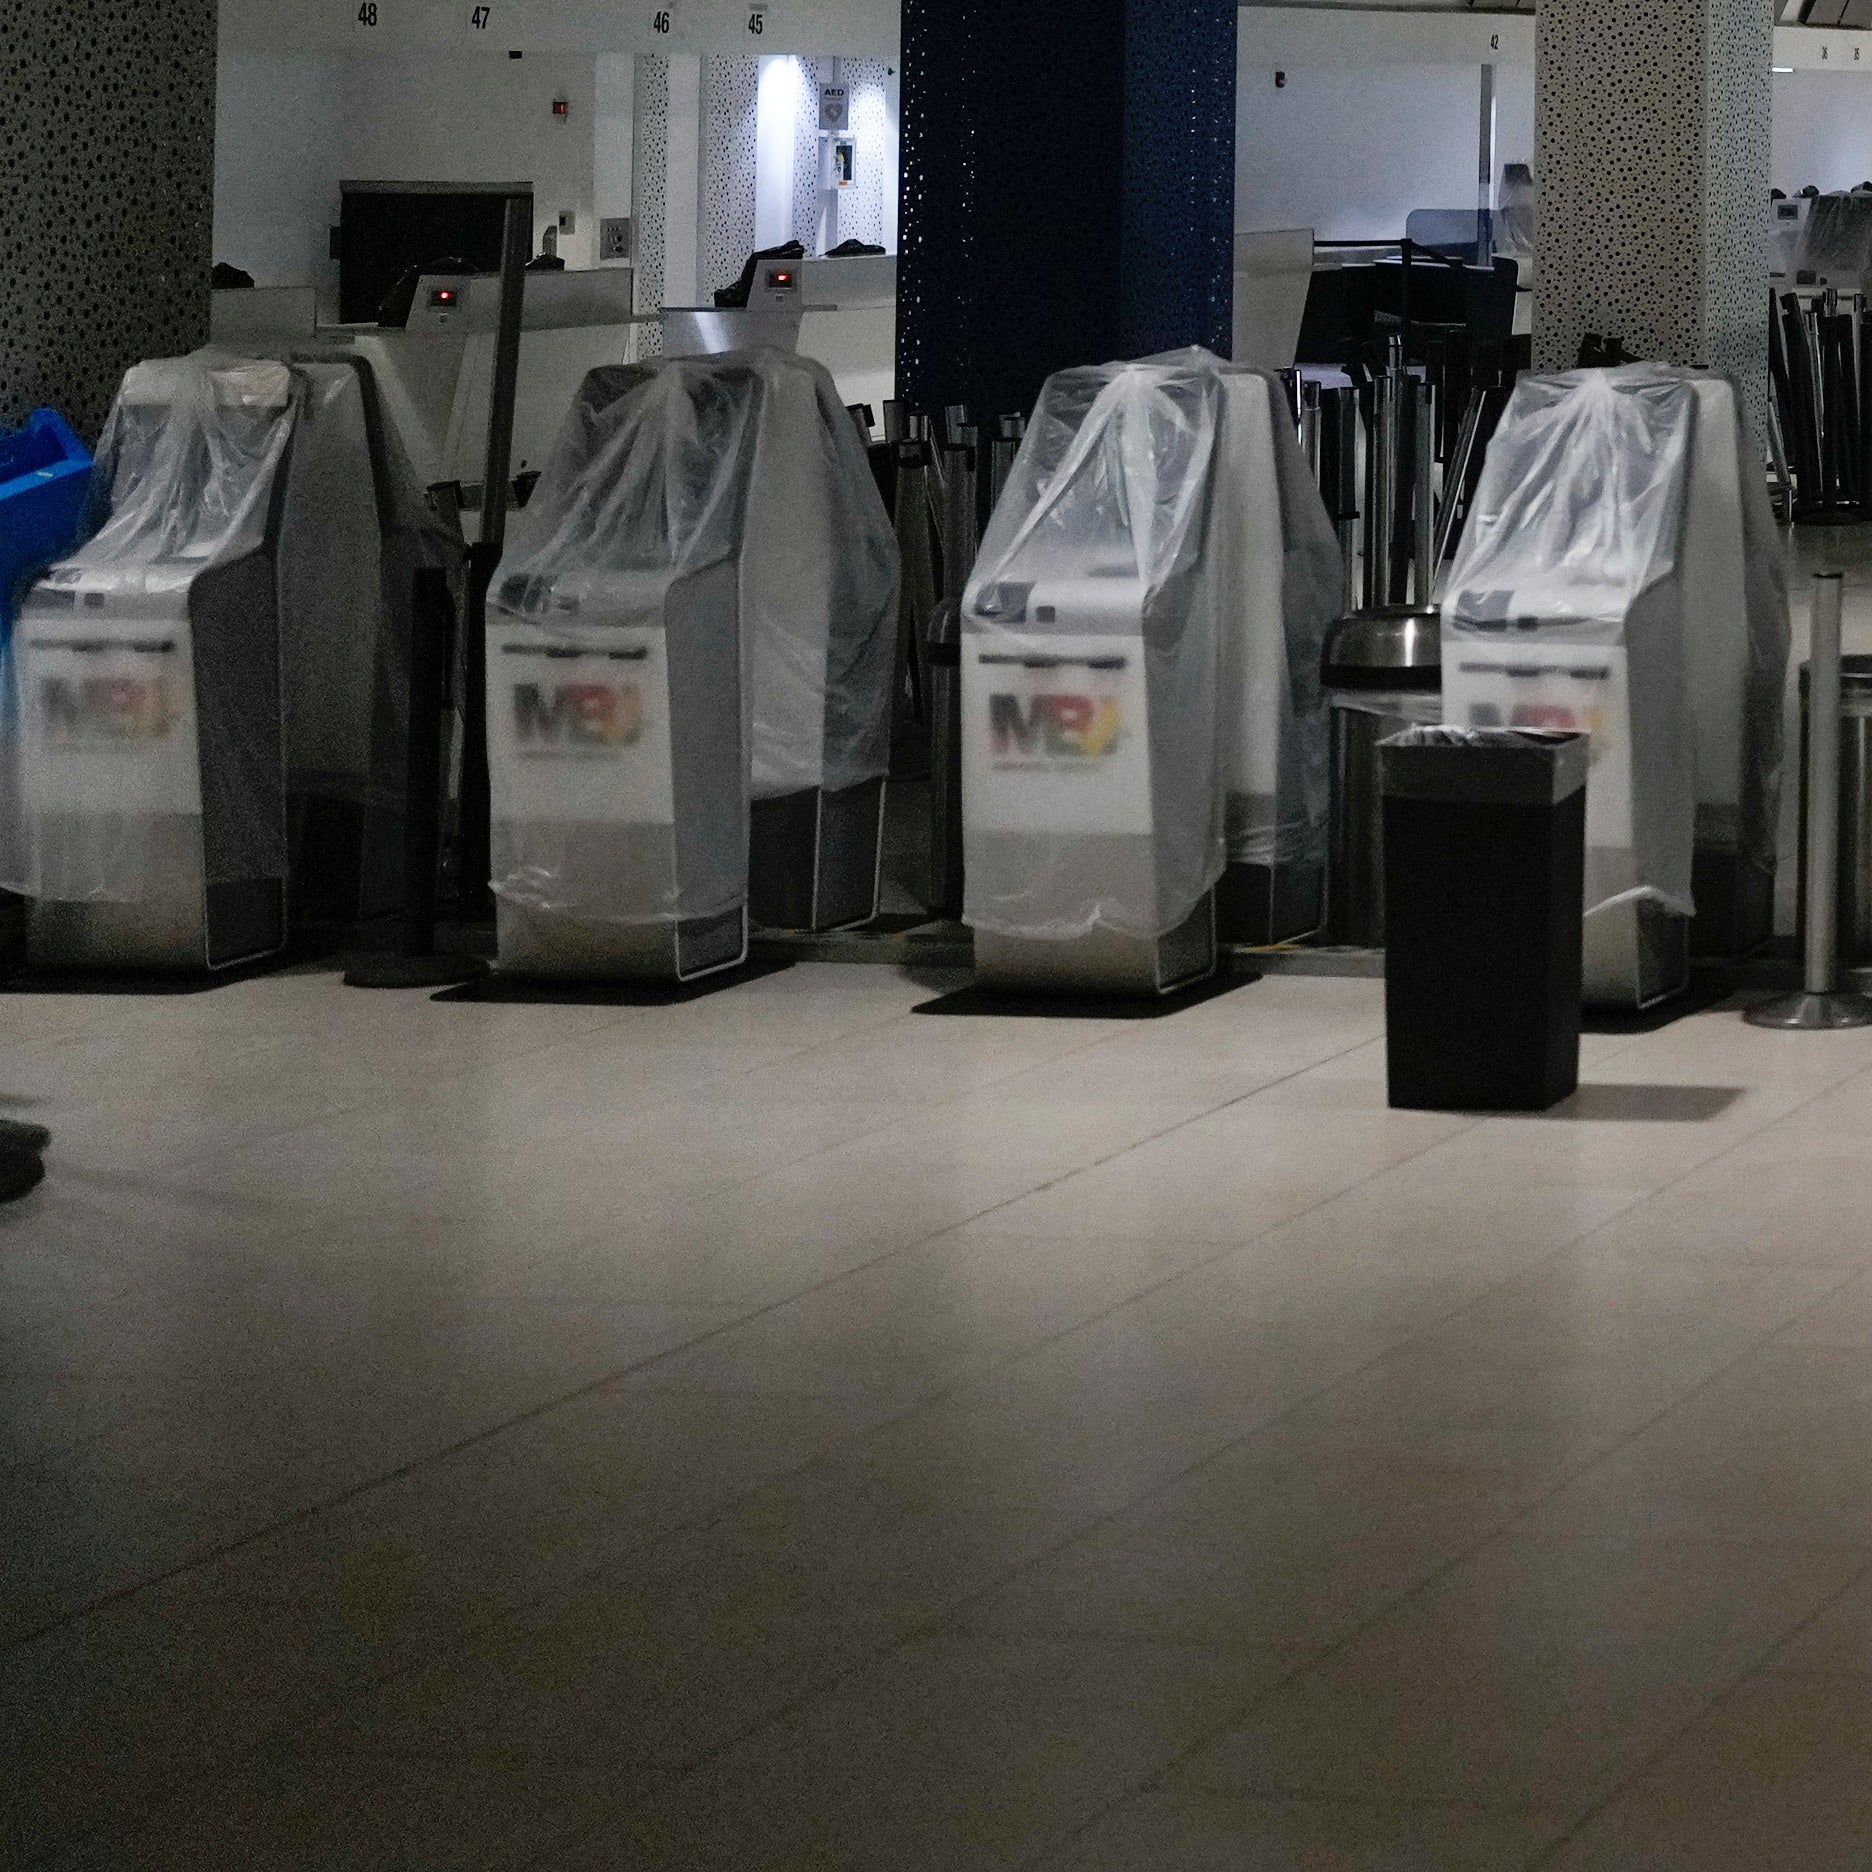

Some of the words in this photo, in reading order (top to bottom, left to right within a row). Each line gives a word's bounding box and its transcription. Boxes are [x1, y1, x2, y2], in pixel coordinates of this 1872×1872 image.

[357, 3, 378, 27] 48
[471, 6, 490, 30] 47
[653, 12, 670, 34] 46
[748, 14, 763, 35] 45
[824, 88, 845, 97] AED
